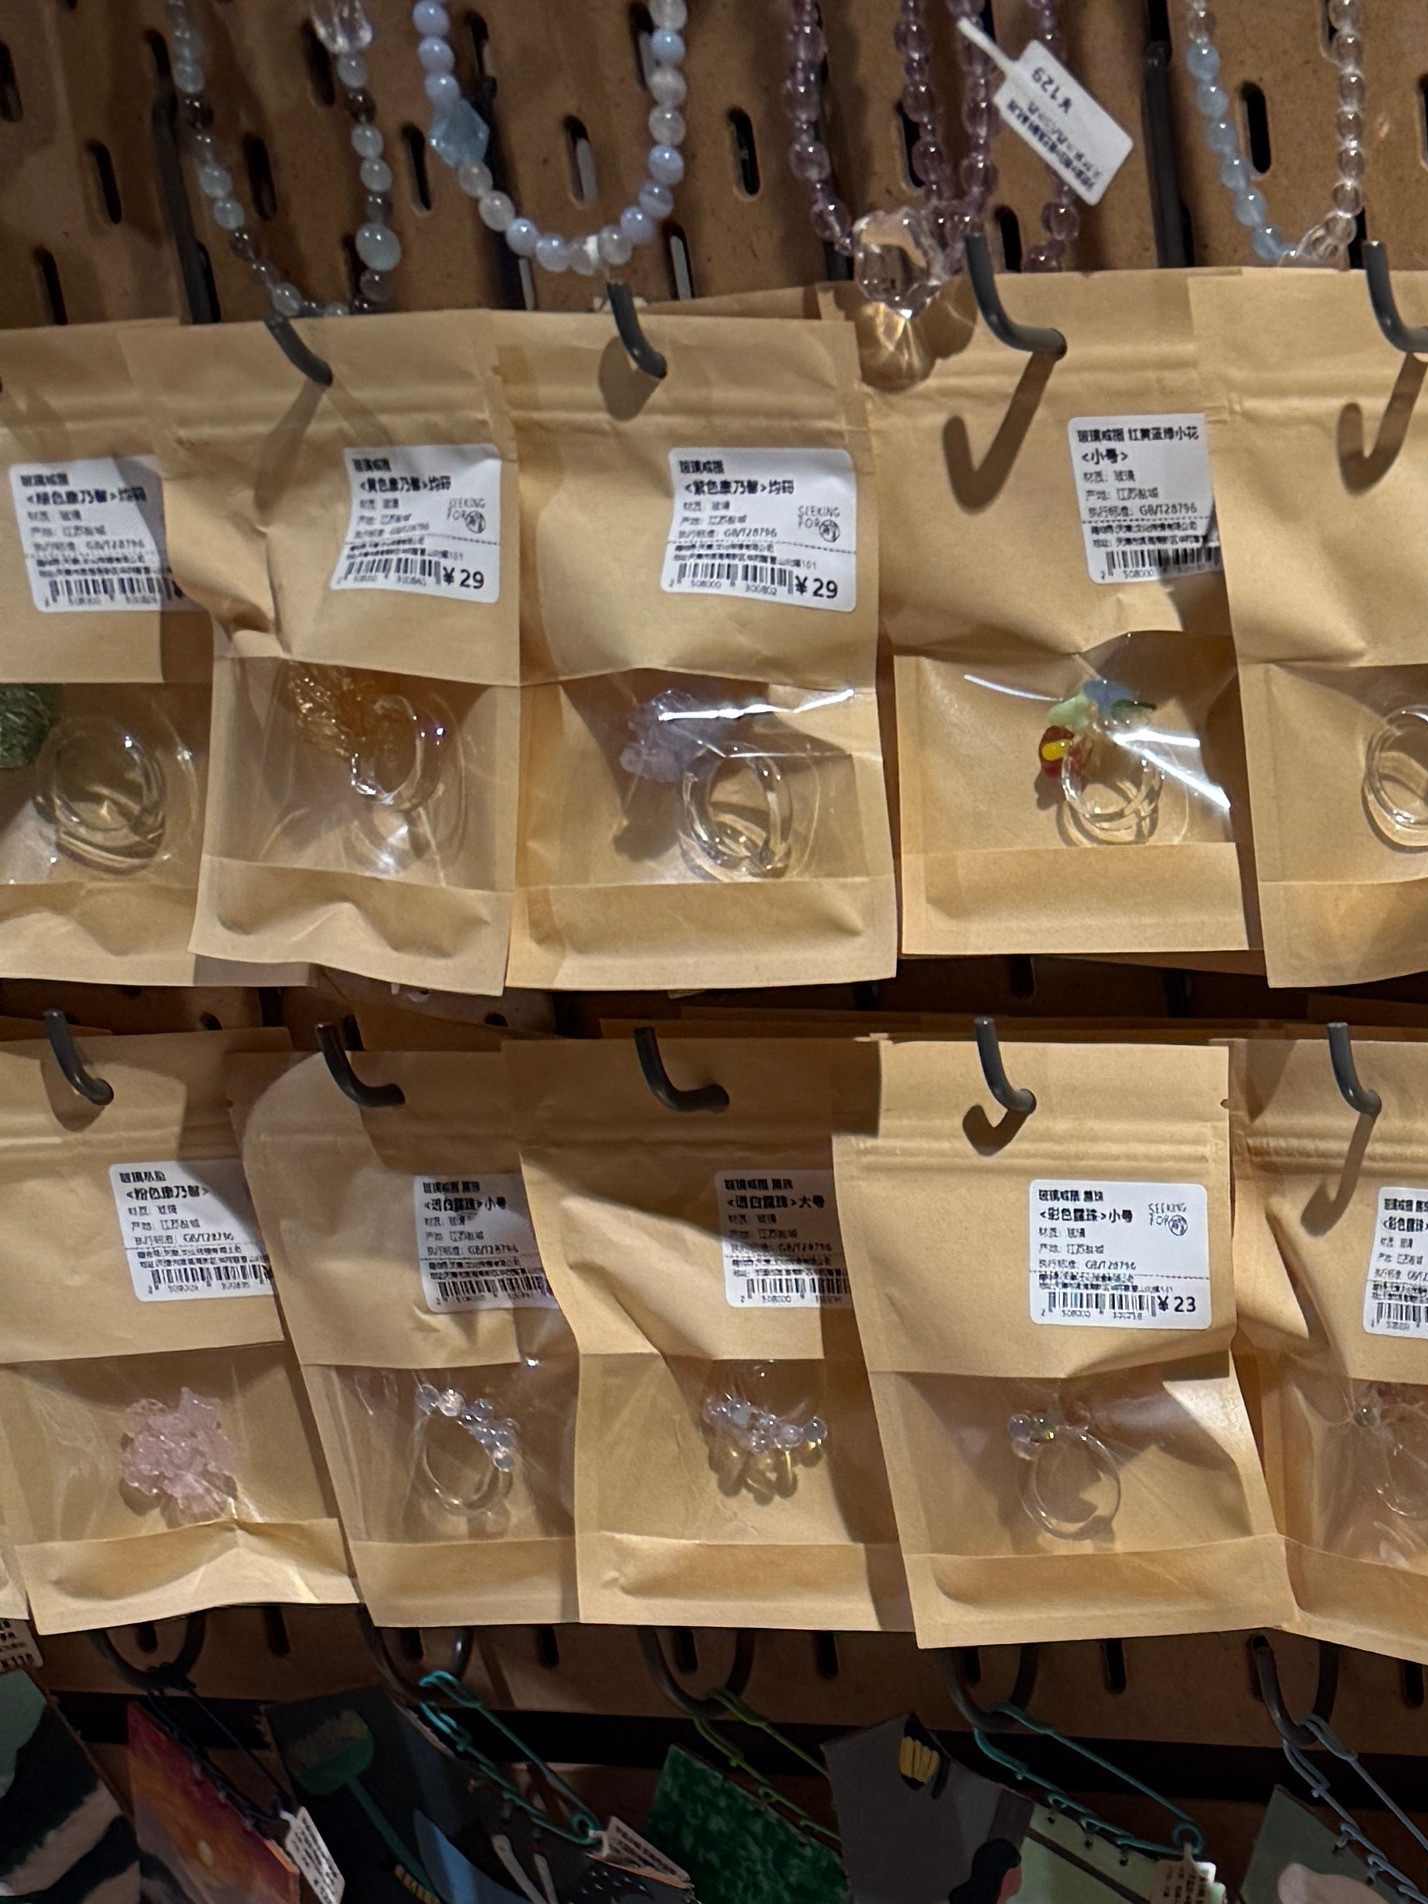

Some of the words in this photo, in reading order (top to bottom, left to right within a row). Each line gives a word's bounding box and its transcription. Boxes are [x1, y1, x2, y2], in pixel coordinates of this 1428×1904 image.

[1081, 448, 1129, 465] <小号>
[442, 566, 485, 590] ¥29
[795, 575, 839, 600] ¥29
[1157, 1295, 1197, 1313] ¥23
